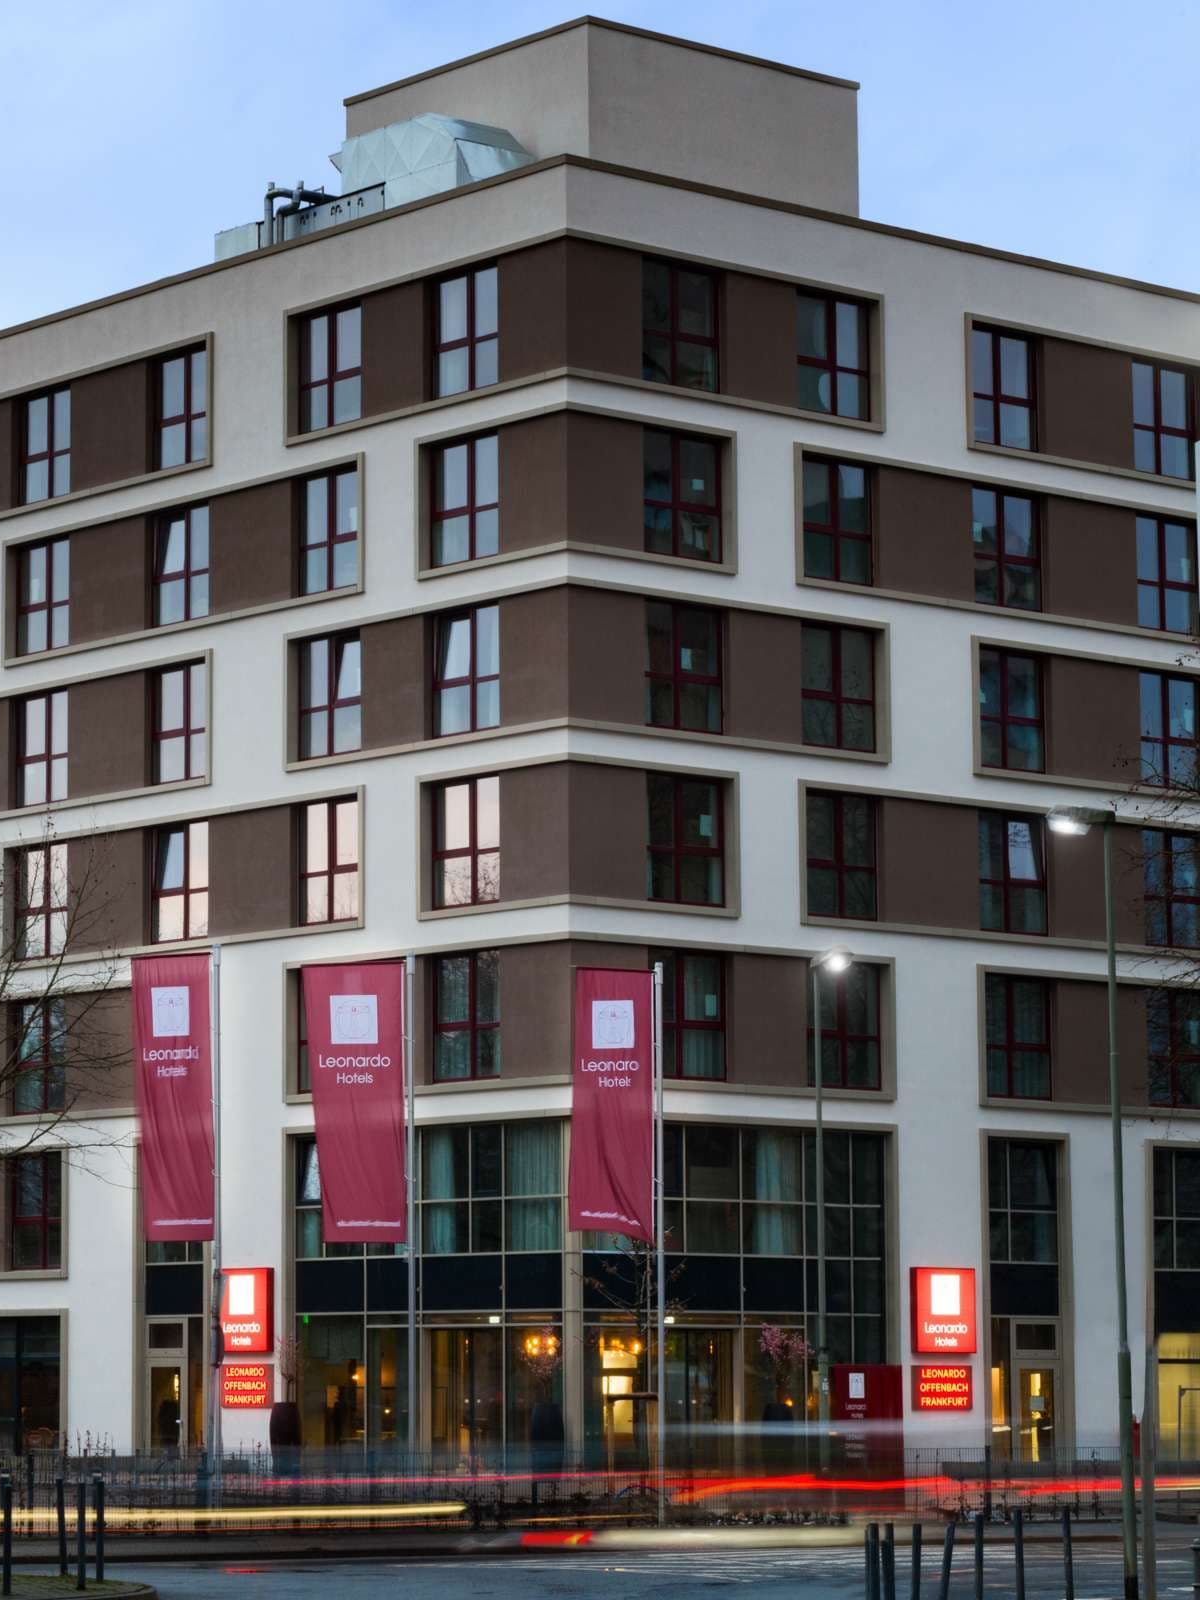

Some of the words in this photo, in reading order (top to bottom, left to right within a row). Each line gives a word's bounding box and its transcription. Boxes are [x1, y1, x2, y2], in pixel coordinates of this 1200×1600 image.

[319, 1053, 391, 1068] Leonardo
[336, 1072, 374, 1084] Hotels
[223, 1321, 261, 1334] Leonardo
[924, 1321, 968, 1335] Leonardo
[231, 1335, 252, 1346] Hotels
[934, 1336, 958, 1347] Hotels
[225, 1367, 265, 1377] LEONARDO
[921, 1368, 966, 1379] LEONARDO
[223, 1381, 267, 1391] OFFENBACH
[919, 1382, 969, 1393] OFFENBACH
[224, 1394, 266, 1405] FRANKFURT
[921, 1396, 968, 1407] FRANKFURT
